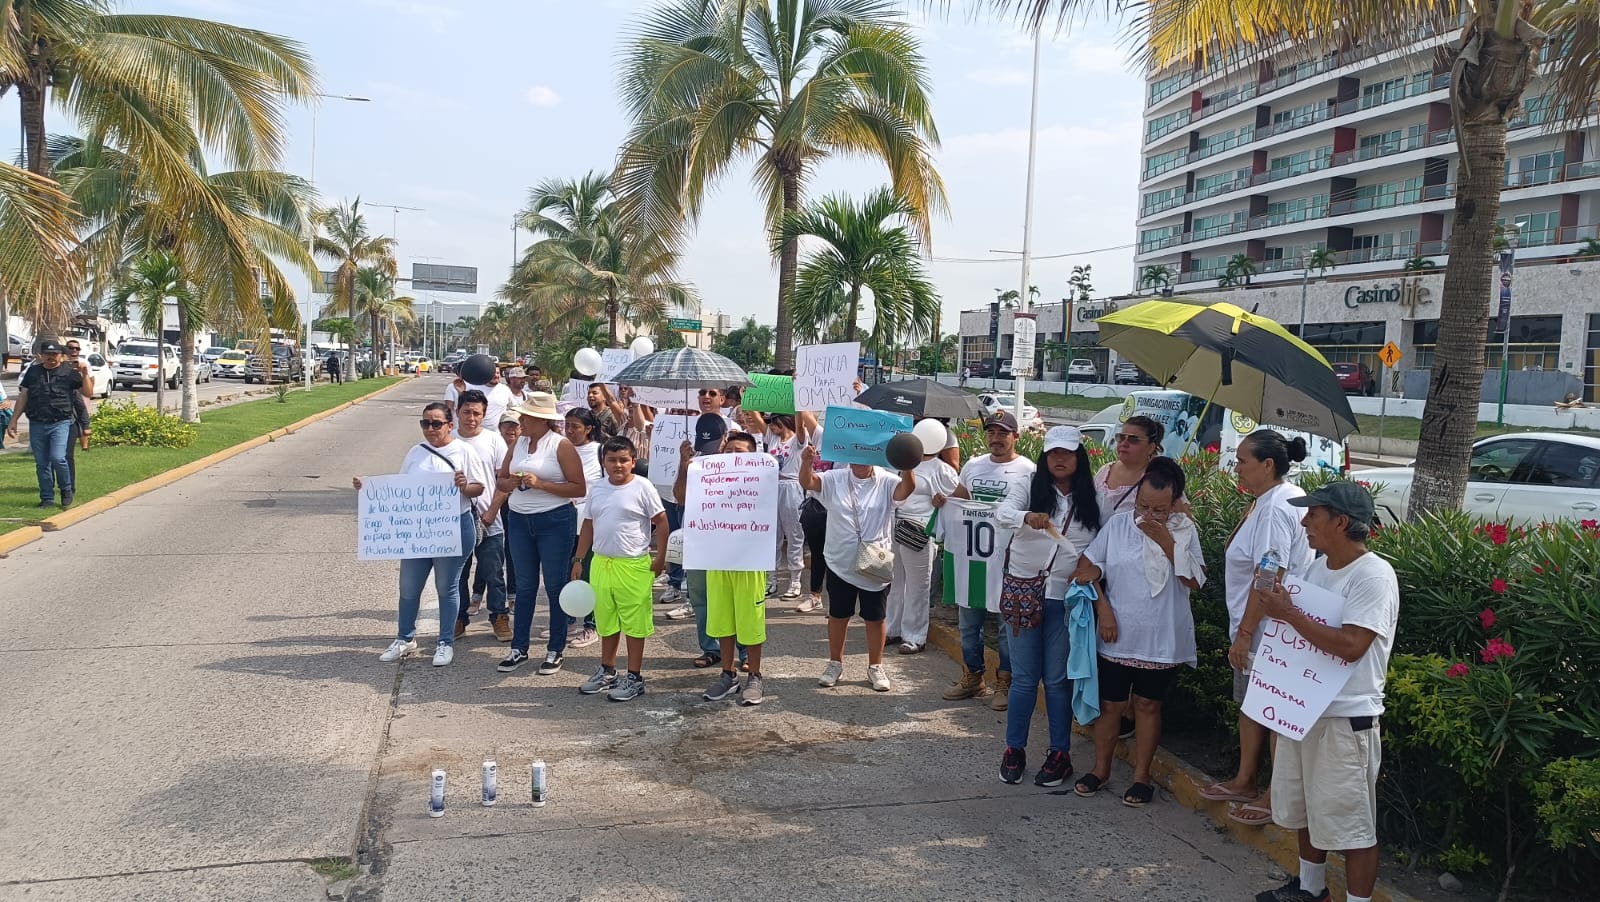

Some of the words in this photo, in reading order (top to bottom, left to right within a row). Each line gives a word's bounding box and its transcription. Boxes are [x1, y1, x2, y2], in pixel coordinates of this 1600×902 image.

[799, 347, 848, 378] JUSTICIA
[767, 390, 794, 409] OMA
[799, 386, 852, 407] OMAR
[701, 457, 726, 474] Tengo
[734, 456, 742, 467] 10
[702, 502, 716, 512] por
[962, 510, 995, 519] FANTASMA
[962, 520, 995, 558] 10
[1302, 668, 1323, 684] EL
